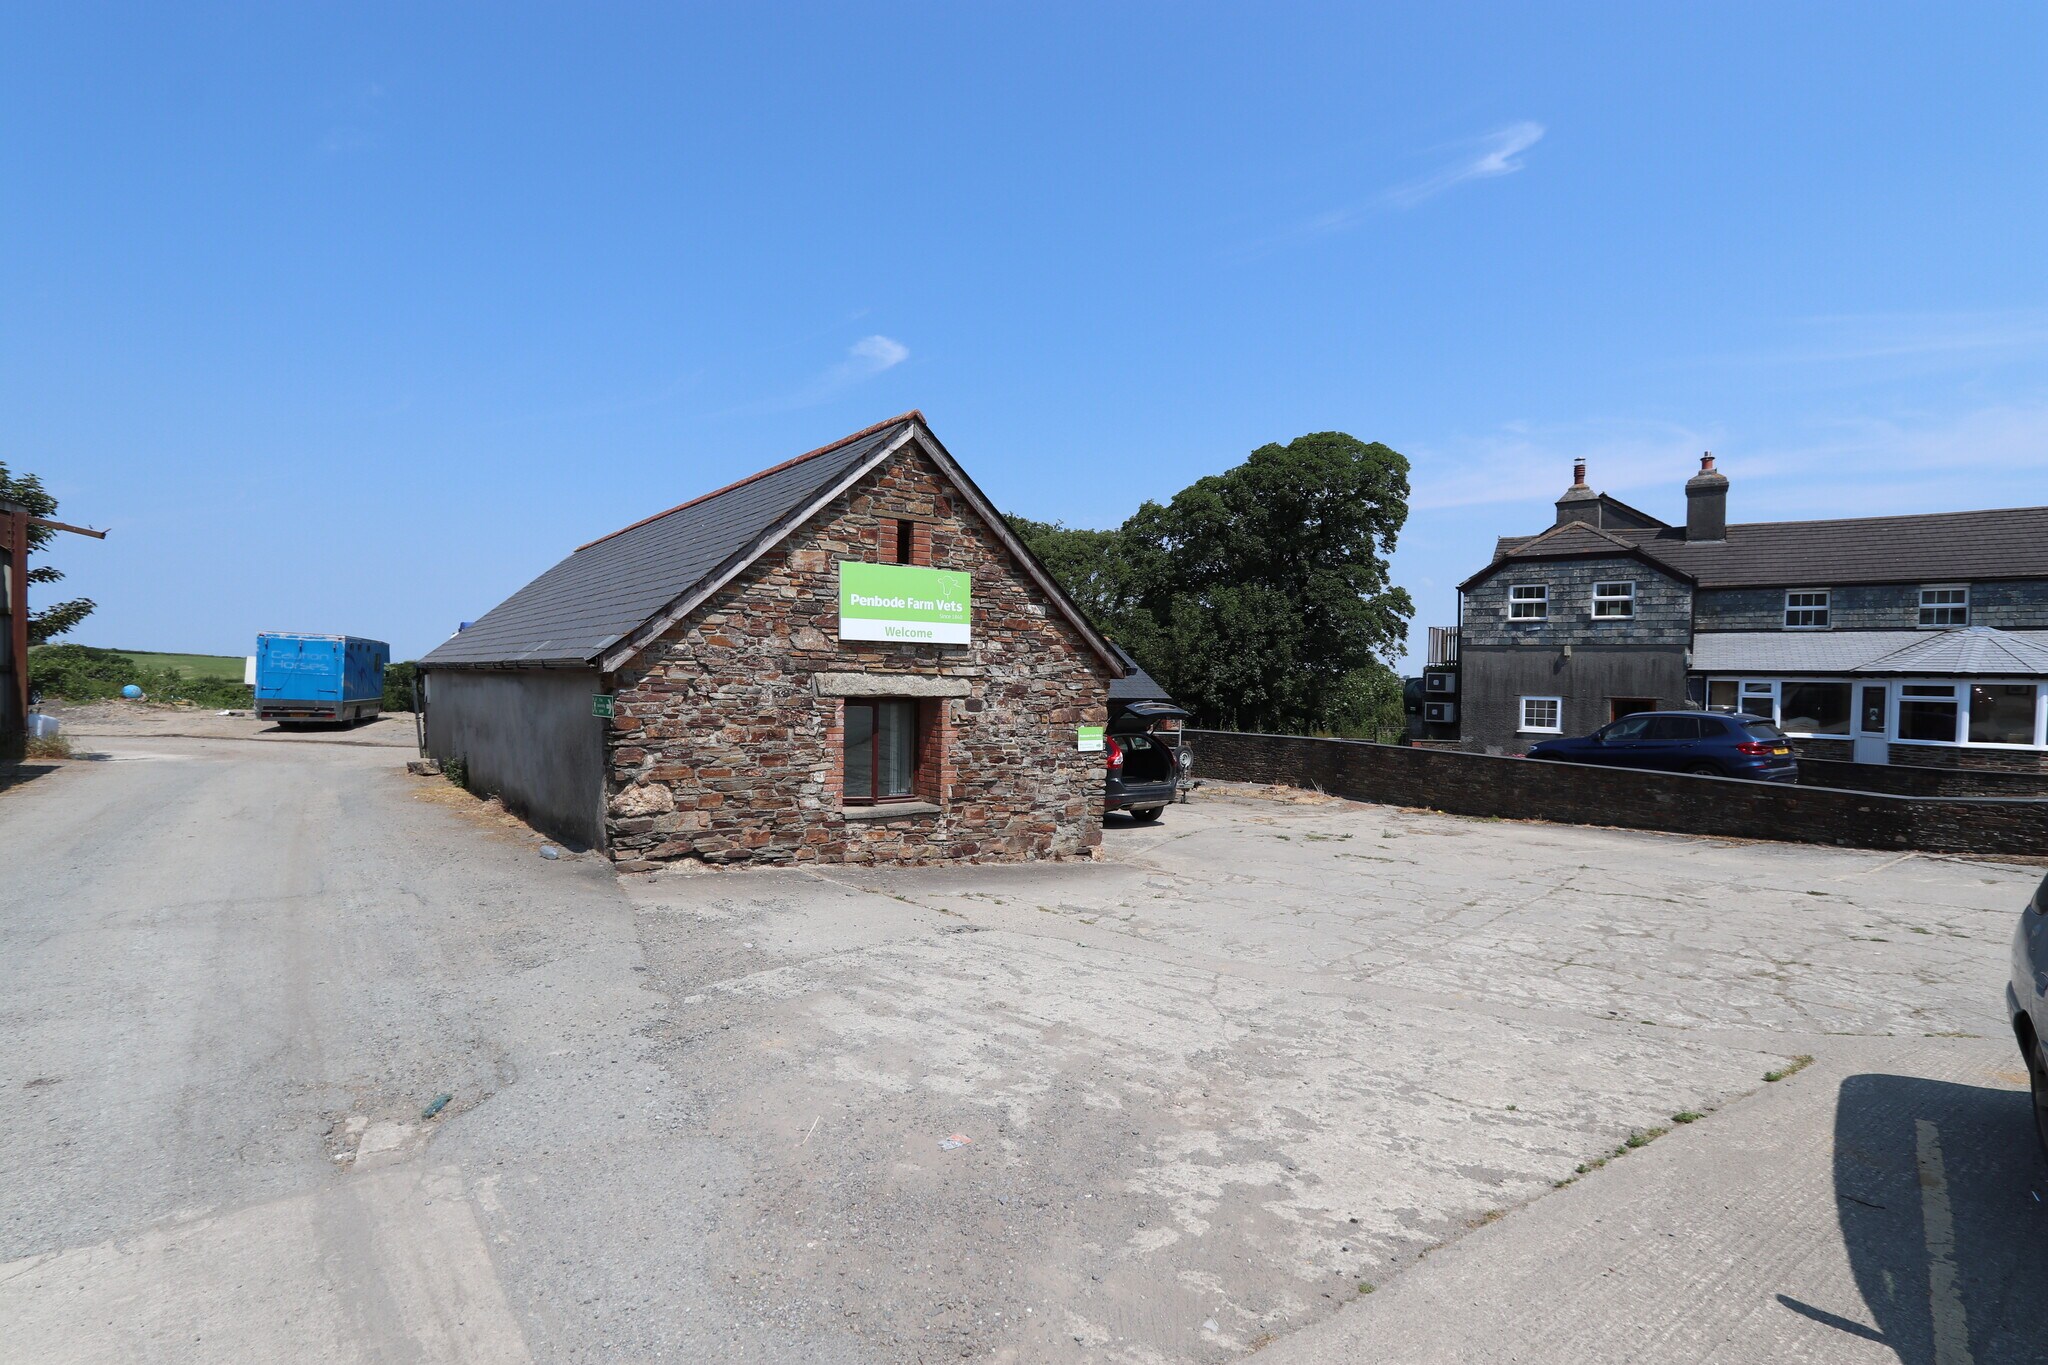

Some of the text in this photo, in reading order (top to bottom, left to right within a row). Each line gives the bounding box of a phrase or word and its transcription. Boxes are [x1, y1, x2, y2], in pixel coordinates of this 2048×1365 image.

[850, 594, 963, 612] Penbode Farm Vets
[885, 626, 933, 638] Welcome
[271, 659, 329, 671] Horses
